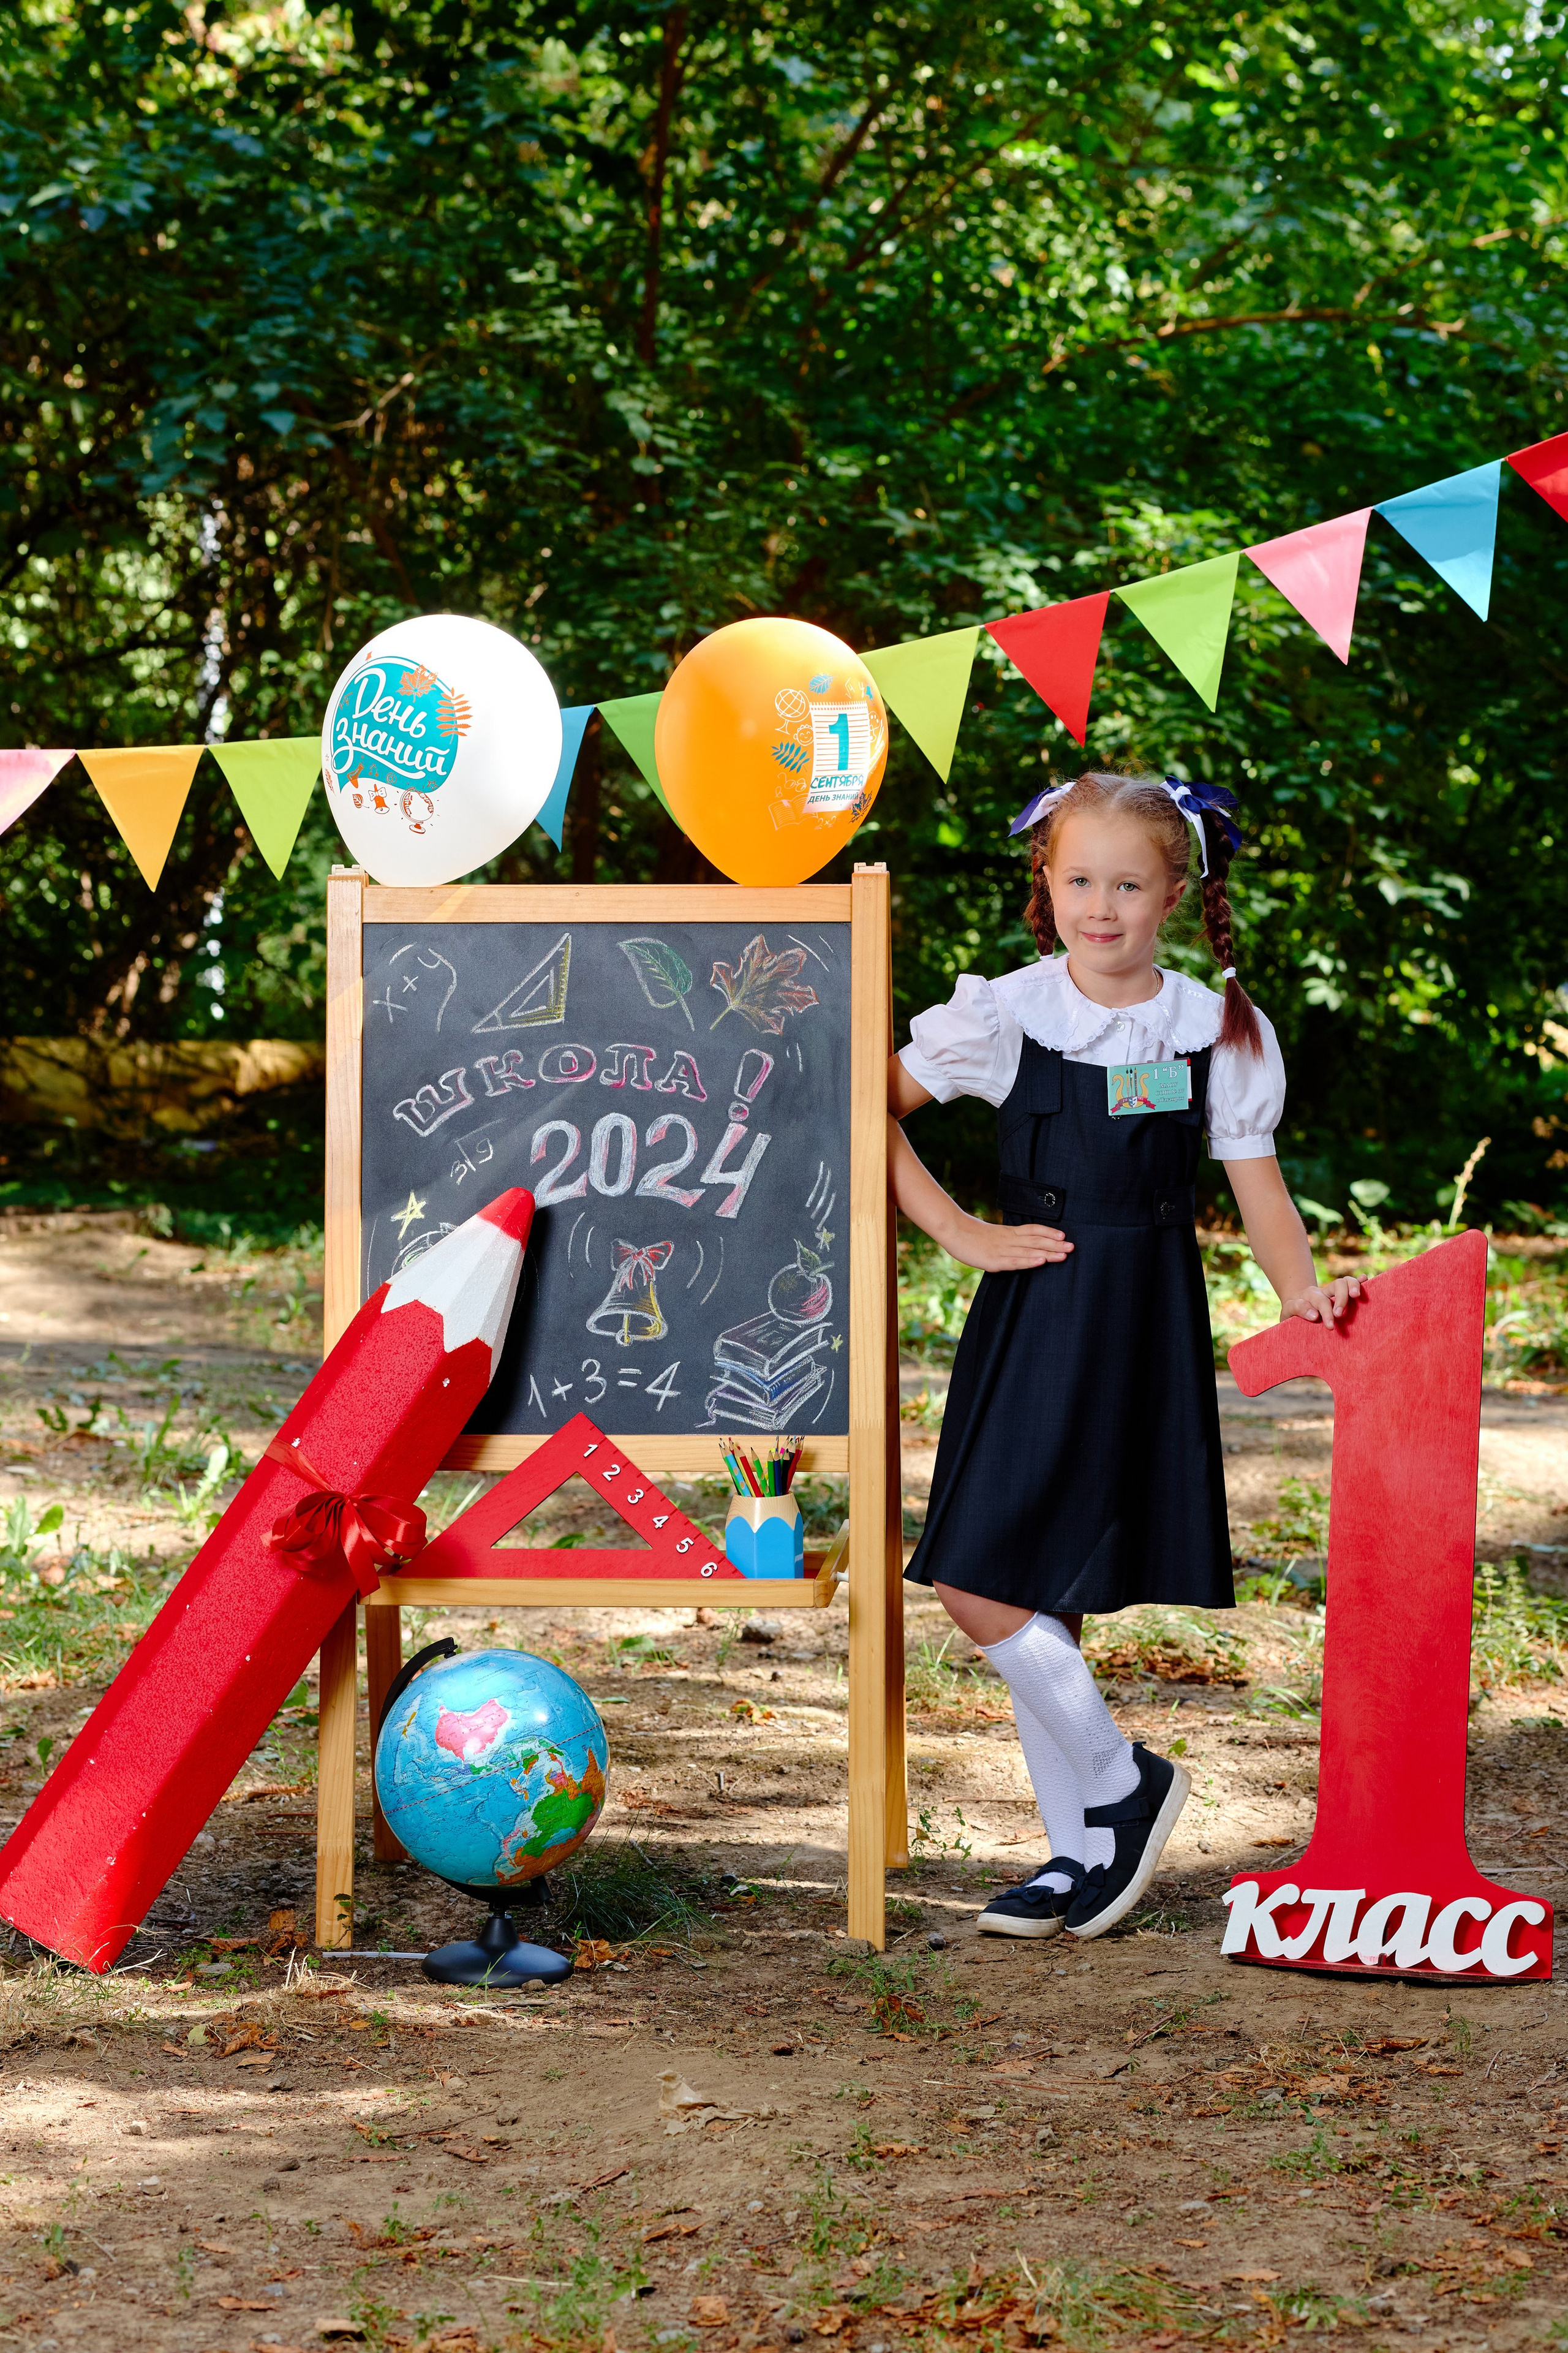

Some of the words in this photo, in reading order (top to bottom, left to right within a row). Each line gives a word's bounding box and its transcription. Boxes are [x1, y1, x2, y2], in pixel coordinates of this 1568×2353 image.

[352, 667, 428, 738] День
[829, 713, 849, 771] 1
[807, 795, 831, 804] ДЕНЬ
[831, 792, 859, 801] ЗНАНИЙ
[810, 774, 864, 789] СЕНТЯБРЯ
[1153, 1068, 1159, 1080] 1
[529, 1111, 772, 1219] 2024
[583, 1443, 598, 1458] 1
[601, 1464, 621, 1482] 2
[627, 1489, 644, 1505] 3
[652, 1514, 669, 1530] 4
[676, 1536, 695, 1554] 5
[700, 1561, 718, 1578] 6
